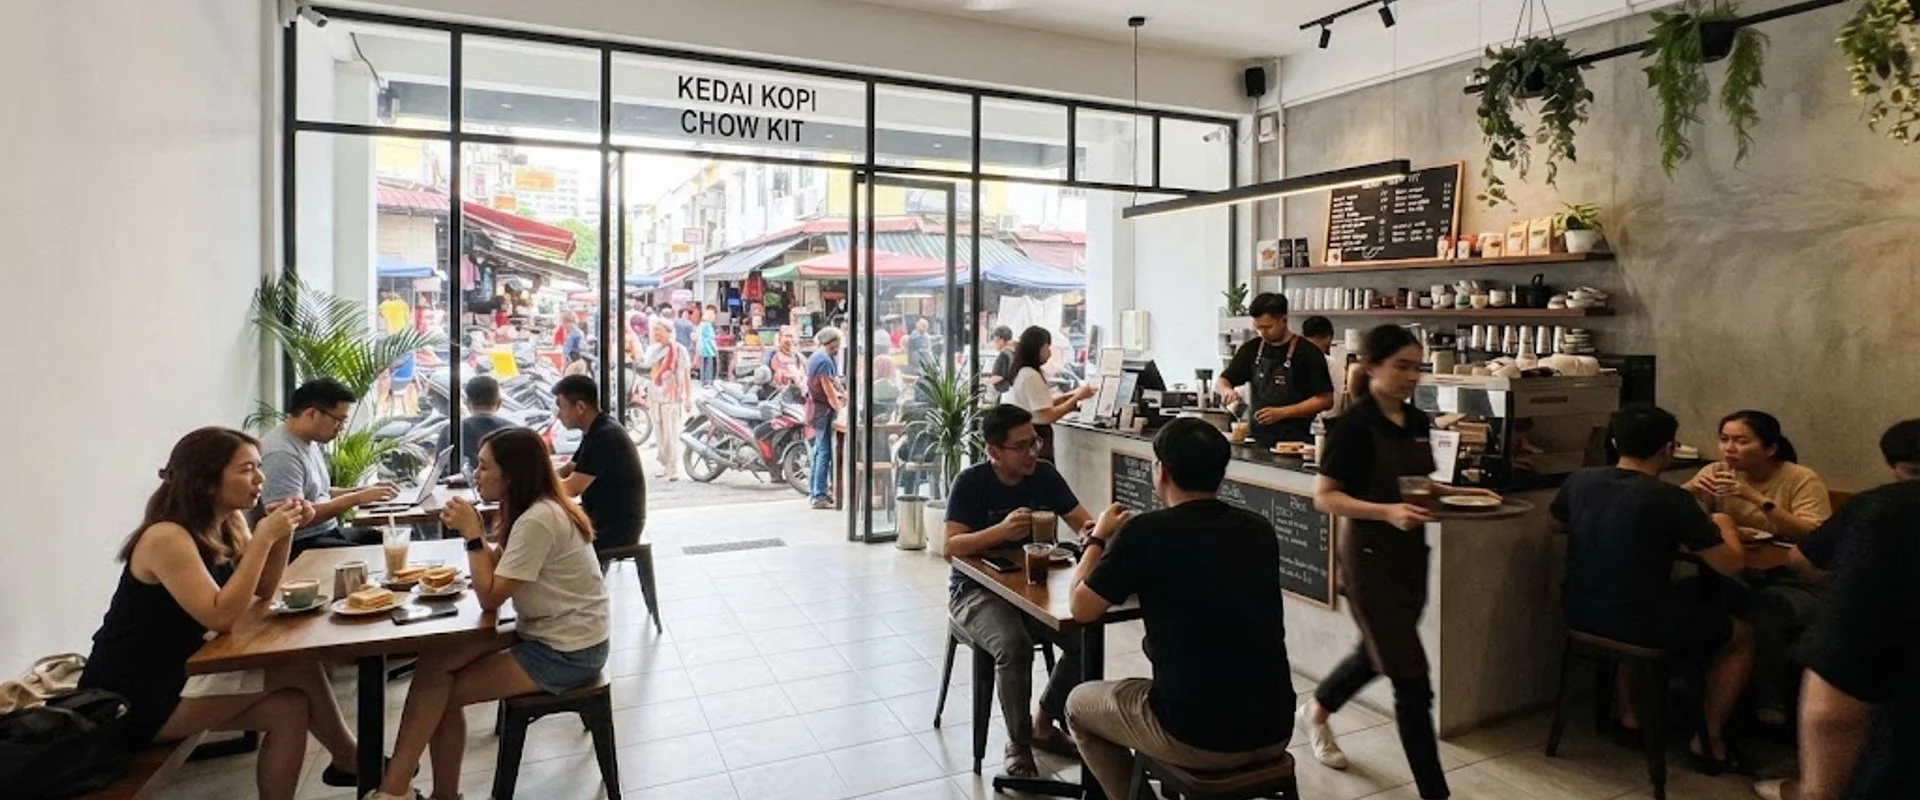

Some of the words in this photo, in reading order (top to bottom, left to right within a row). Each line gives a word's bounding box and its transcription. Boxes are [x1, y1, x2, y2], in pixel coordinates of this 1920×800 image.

[678, 75, 753, 106] KEDAI
[761, 84, 816, 112] KOPI
[681, 109, 759, 139] CHOW
[767, 117, 804, 142] KIT
